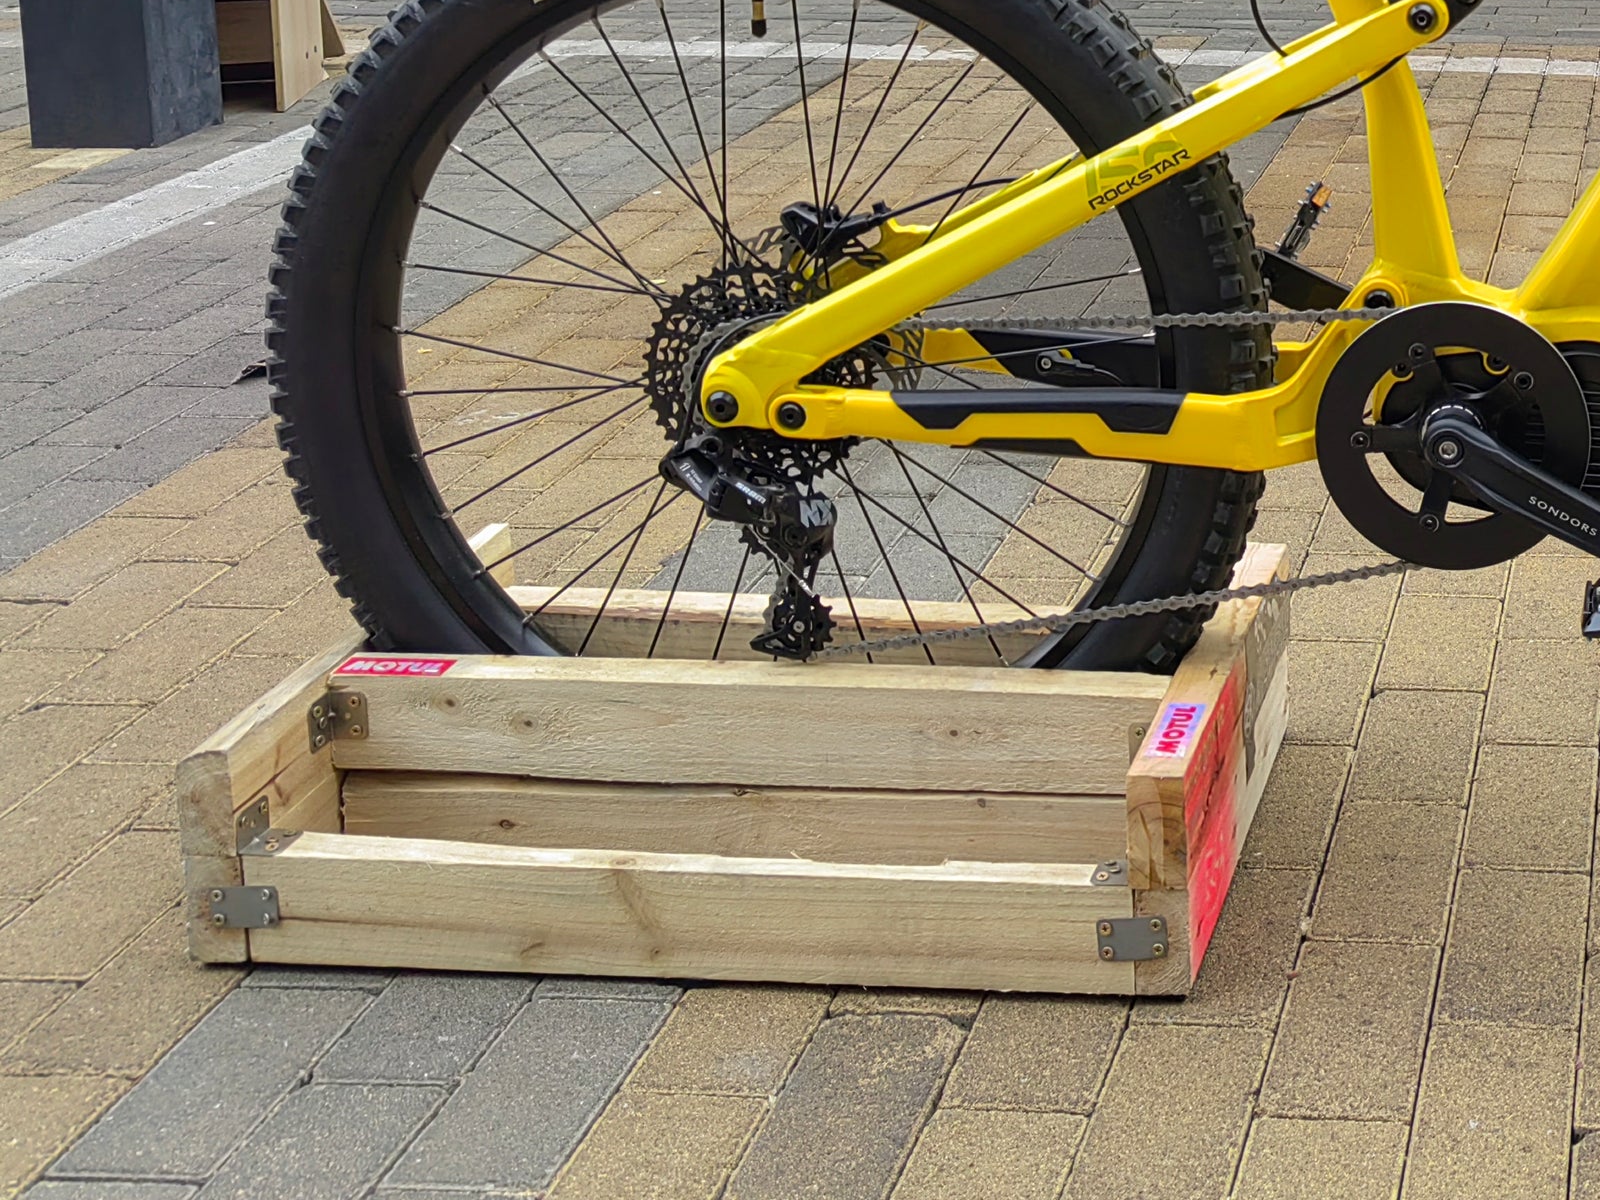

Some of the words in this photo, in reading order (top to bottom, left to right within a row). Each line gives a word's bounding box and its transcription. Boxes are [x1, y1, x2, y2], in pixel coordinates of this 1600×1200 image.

[1088, 148, 1192, 211] ROCKSTAR
[735, 481, 767, 504] SRAM
[800, 498, 834, 529] NX
[1528, 495, 1599, 537] SONDORS
[342, 660, 445, 673] MOTUL
[1155, 704, 1198, 754] MOTUL
